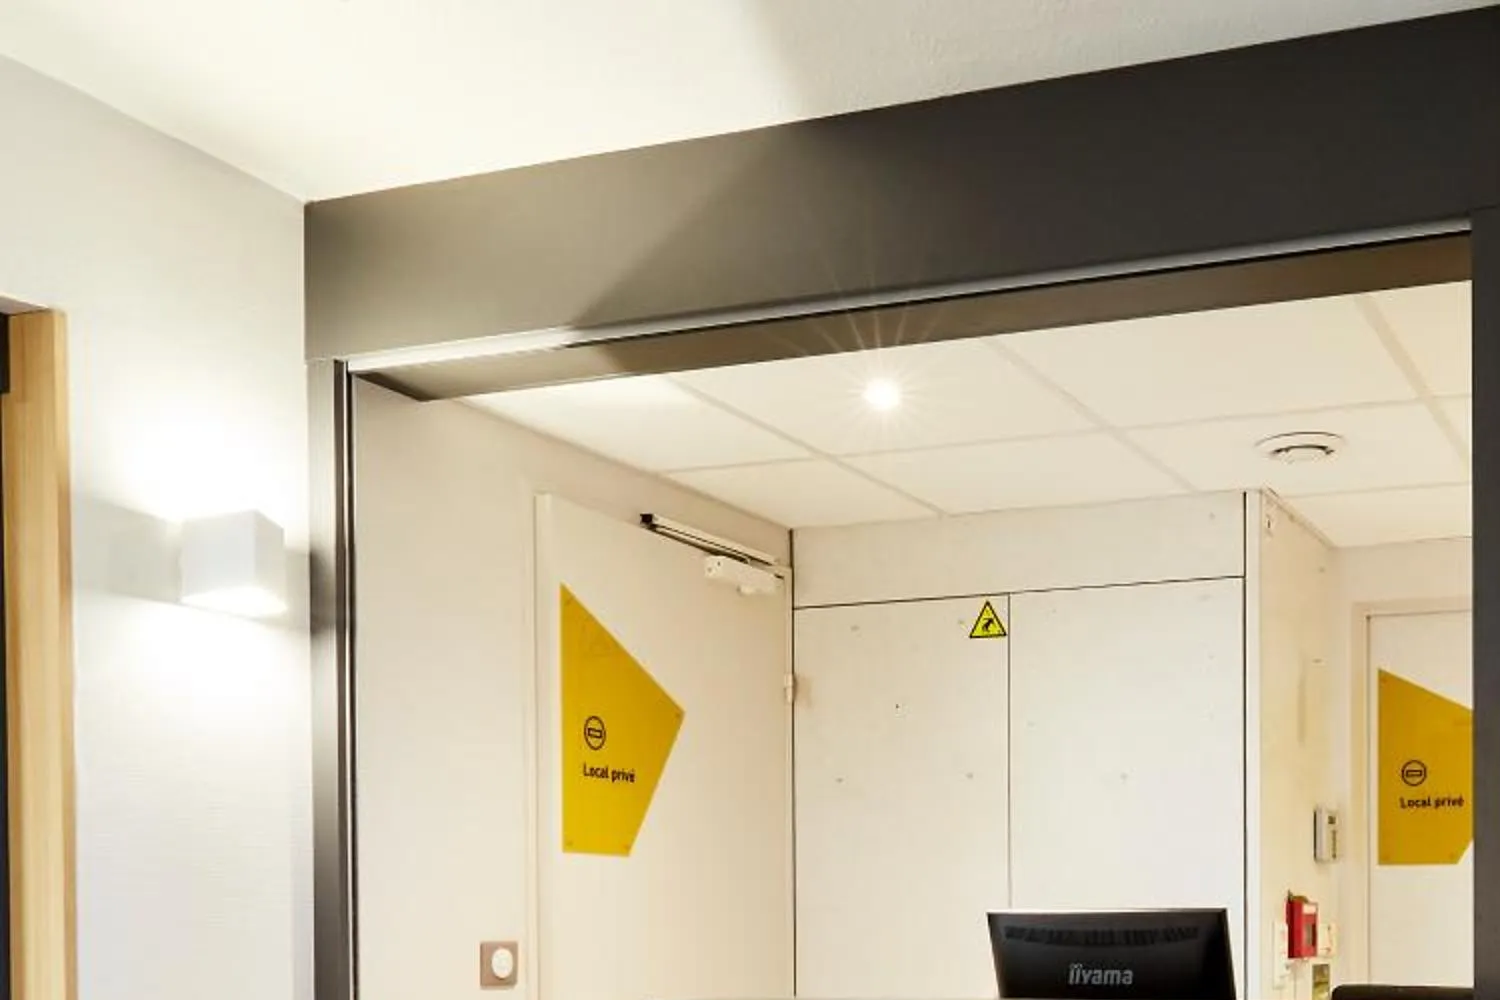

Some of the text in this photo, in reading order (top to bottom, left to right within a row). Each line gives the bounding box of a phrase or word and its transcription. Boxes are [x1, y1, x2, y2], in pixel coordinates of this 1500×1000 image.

[583, 761, 636, 783] Local privé
[1399, 794, 1464, 809] Local privé
[1068, 963, 1134, 985] iiyama
